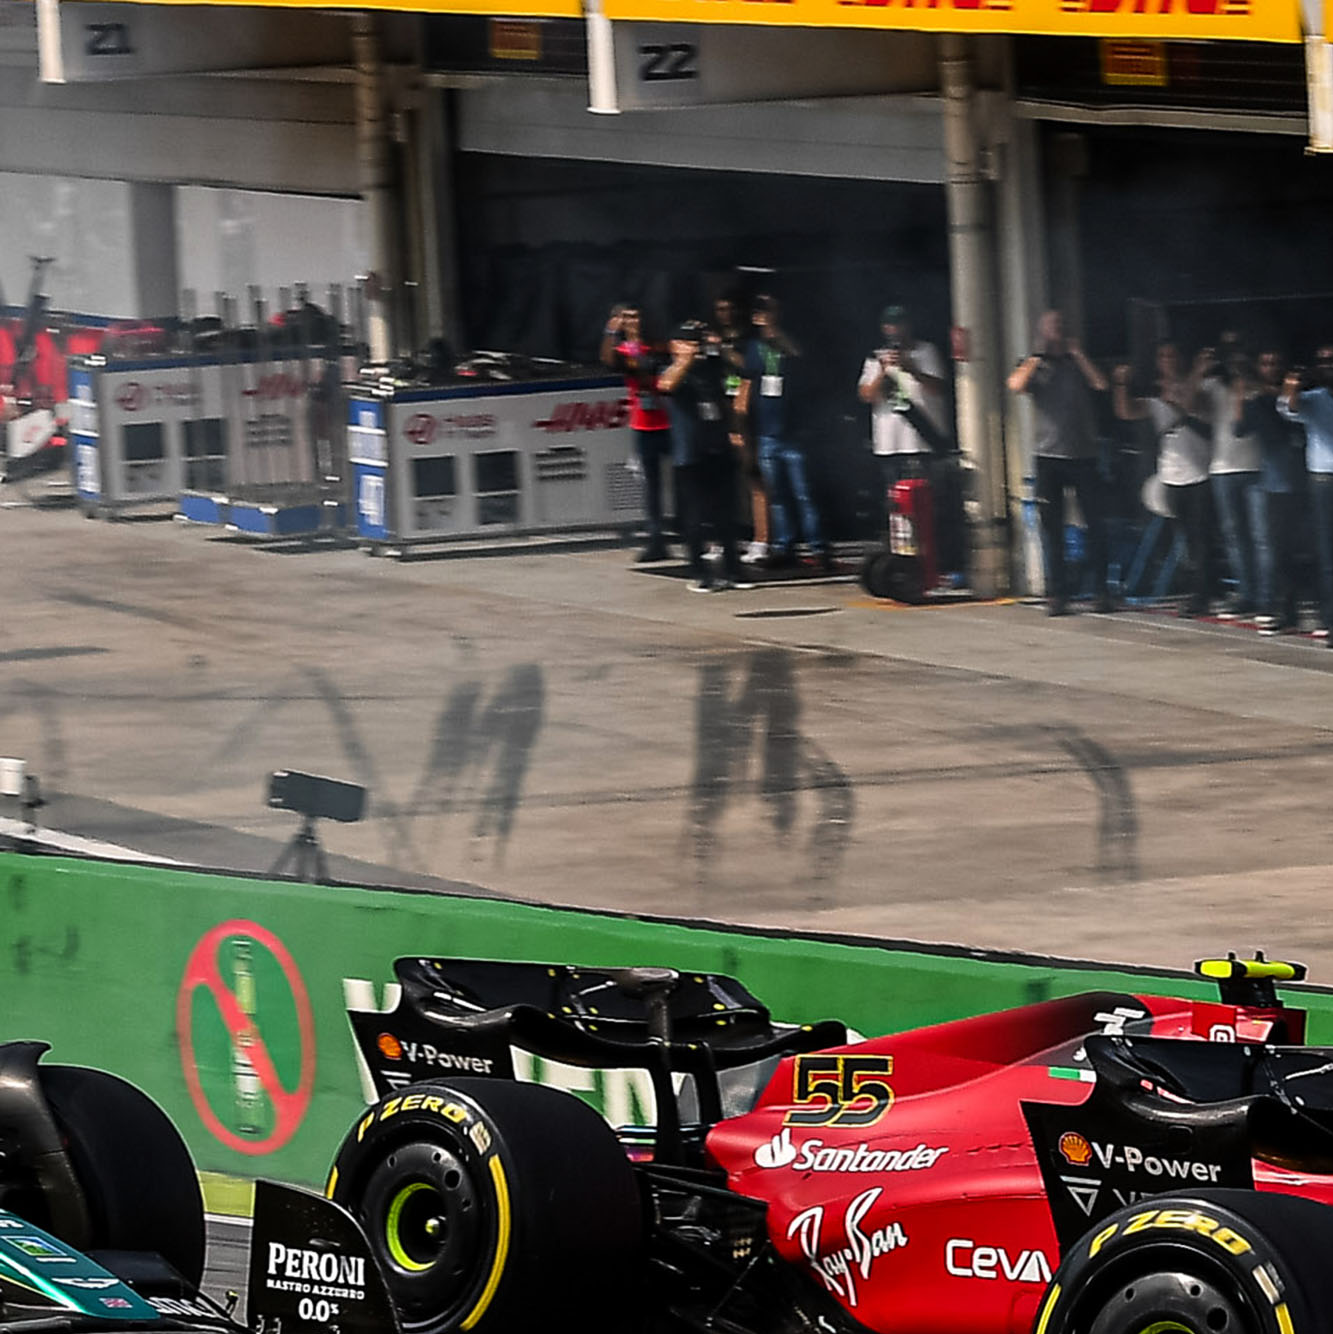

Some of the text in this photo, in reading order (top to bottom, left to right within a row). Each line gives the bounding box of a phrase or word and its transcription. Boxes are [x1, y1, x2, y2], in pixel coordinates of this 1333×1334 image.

[638, 43, 698, 82] 22
[401, 1041, 493, 1074] V-Power
[782, 1053, 895, 1128] 55
[357, 1093, 468, 1144] P ZERO
[792, 1139, 949, 1172] Santander
[1091, 1141, 1222, 1183] V-Power
[1089, 1209, 1253, 1259] P ZERO
[267, 1241, 366, 1286] PERONI
